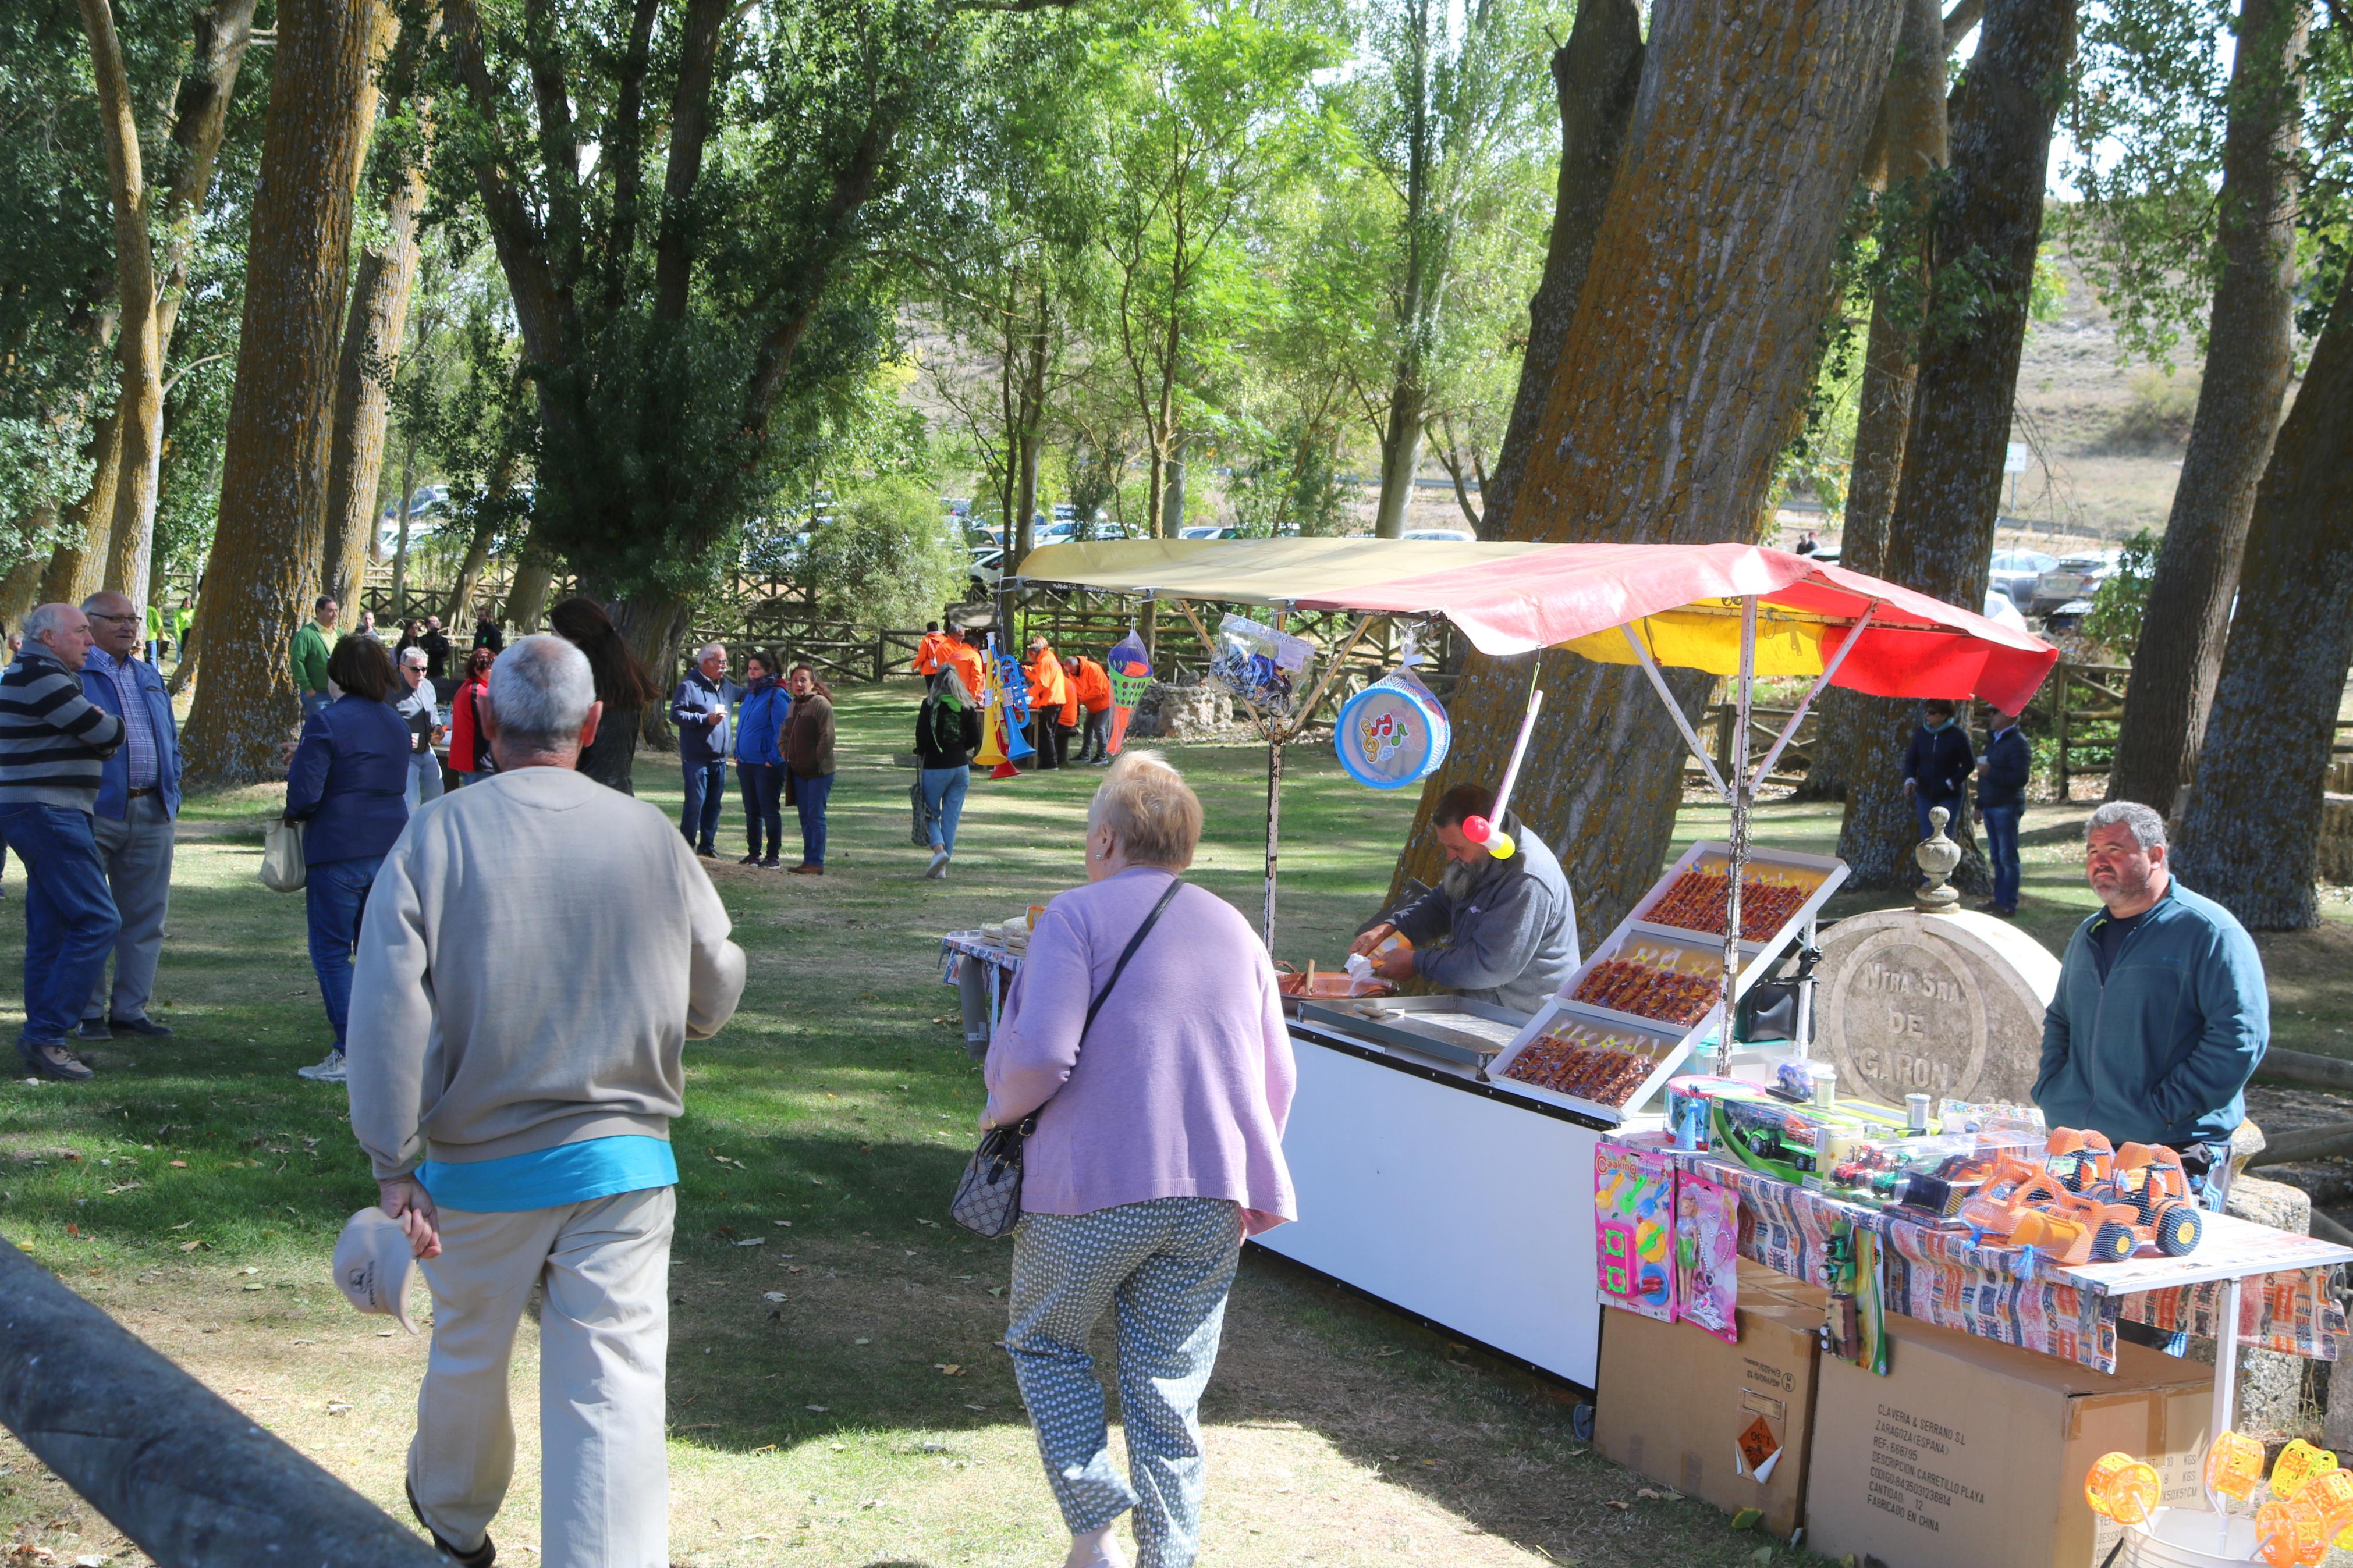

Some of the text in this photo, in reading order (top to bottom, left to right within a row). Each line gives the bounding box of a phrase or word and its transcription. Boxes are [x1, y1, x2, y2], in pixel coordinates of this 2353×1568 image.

[1888, 1007, 1926, 1039] DE
[1596, 1155, 1637, 1181] Cooking
[1878, 1403, 1910, 1425] CLAVERIA
[1912, 1417, 1918, 1428] &
[1919, 1418, 1953, 1440] SERRANO
[1751, 1431, 1770, 1446] 1.3G
[1890, 1442, 1918, 1462] 668795
[2183, 1454, 2196, 1466] KGS
[2164, 1470, 2195, 1484] 8 KGS
[1869, 1481, 1923, 1511] CANTIDAD: 12
[1961, 1485, 1985, 1505] PLAYA
[1867, 1494, 1939, 1533] FABRICADO EN CHINA
